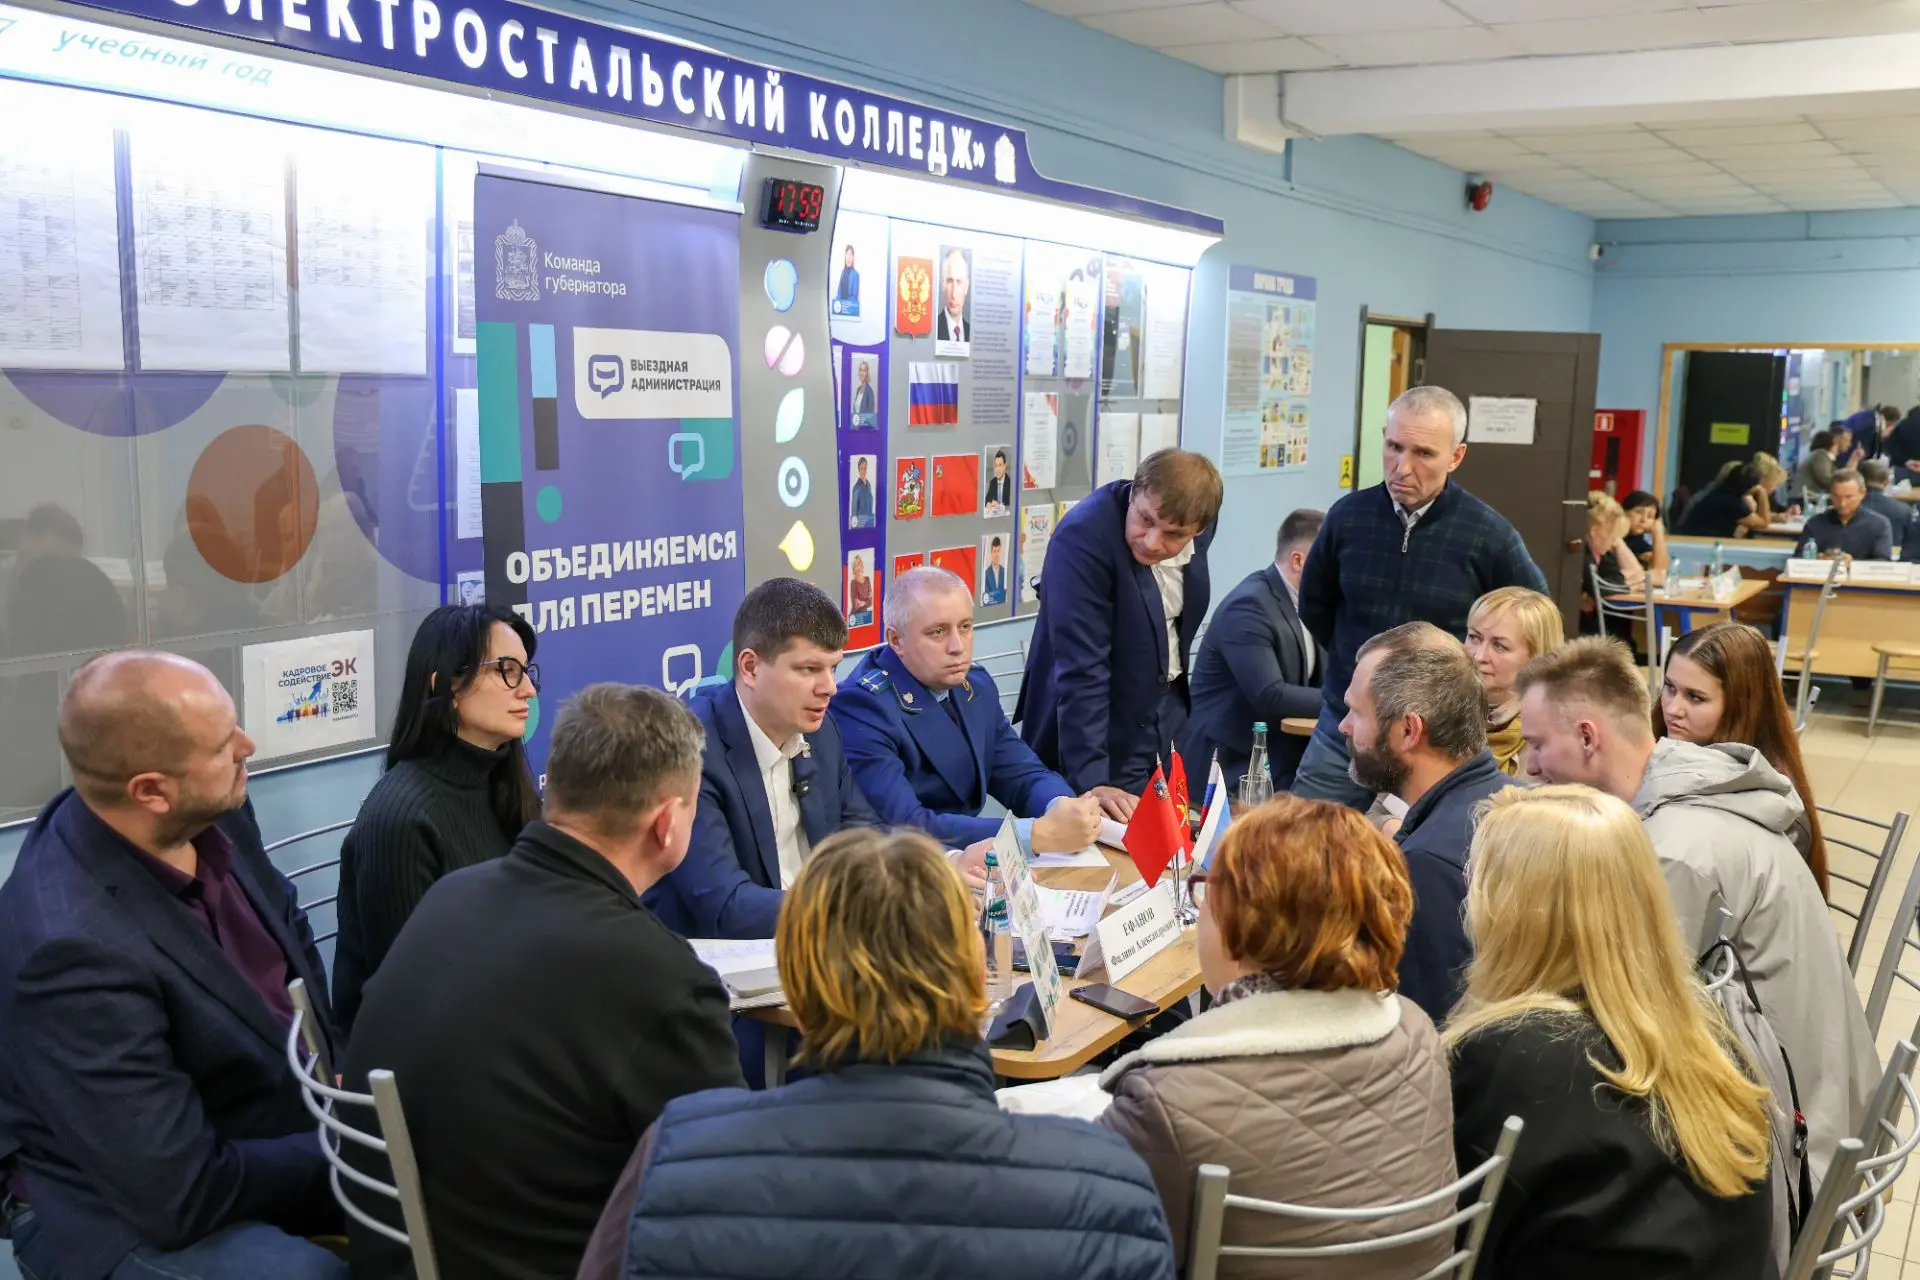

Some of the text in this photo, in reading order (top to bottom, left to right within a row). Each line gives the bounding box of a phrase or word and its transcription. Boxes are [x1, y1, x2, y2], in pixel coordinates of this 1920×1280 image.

[52, 29, 209, 71] учебный
[222, 61, 274, 88] год
[809, 91, 986, 177] КОЛЛЕДЖ»
[544, 252, 601, 274] Команда
[544, 274, 627, 298] губернатора
[630, 358, 689, 374] ВЫЕЗДНАЯ
[630, 376, 721, 392] АДМИНИСТРАЦИЯ
[506, 530, 737, 584] ОБЪЕДИНЯЕМСЯ
[581, 579, 712, 625] ПЕРЕМЕН
[283, 664, 327, 677] КАДРОВОЕ
[331, 657, 358, 678] ЭК
[279, 672, 331, 687] СОДЕЙСТВИЕ
[1122, 906, 1155, 937] ЕФАНОВ
